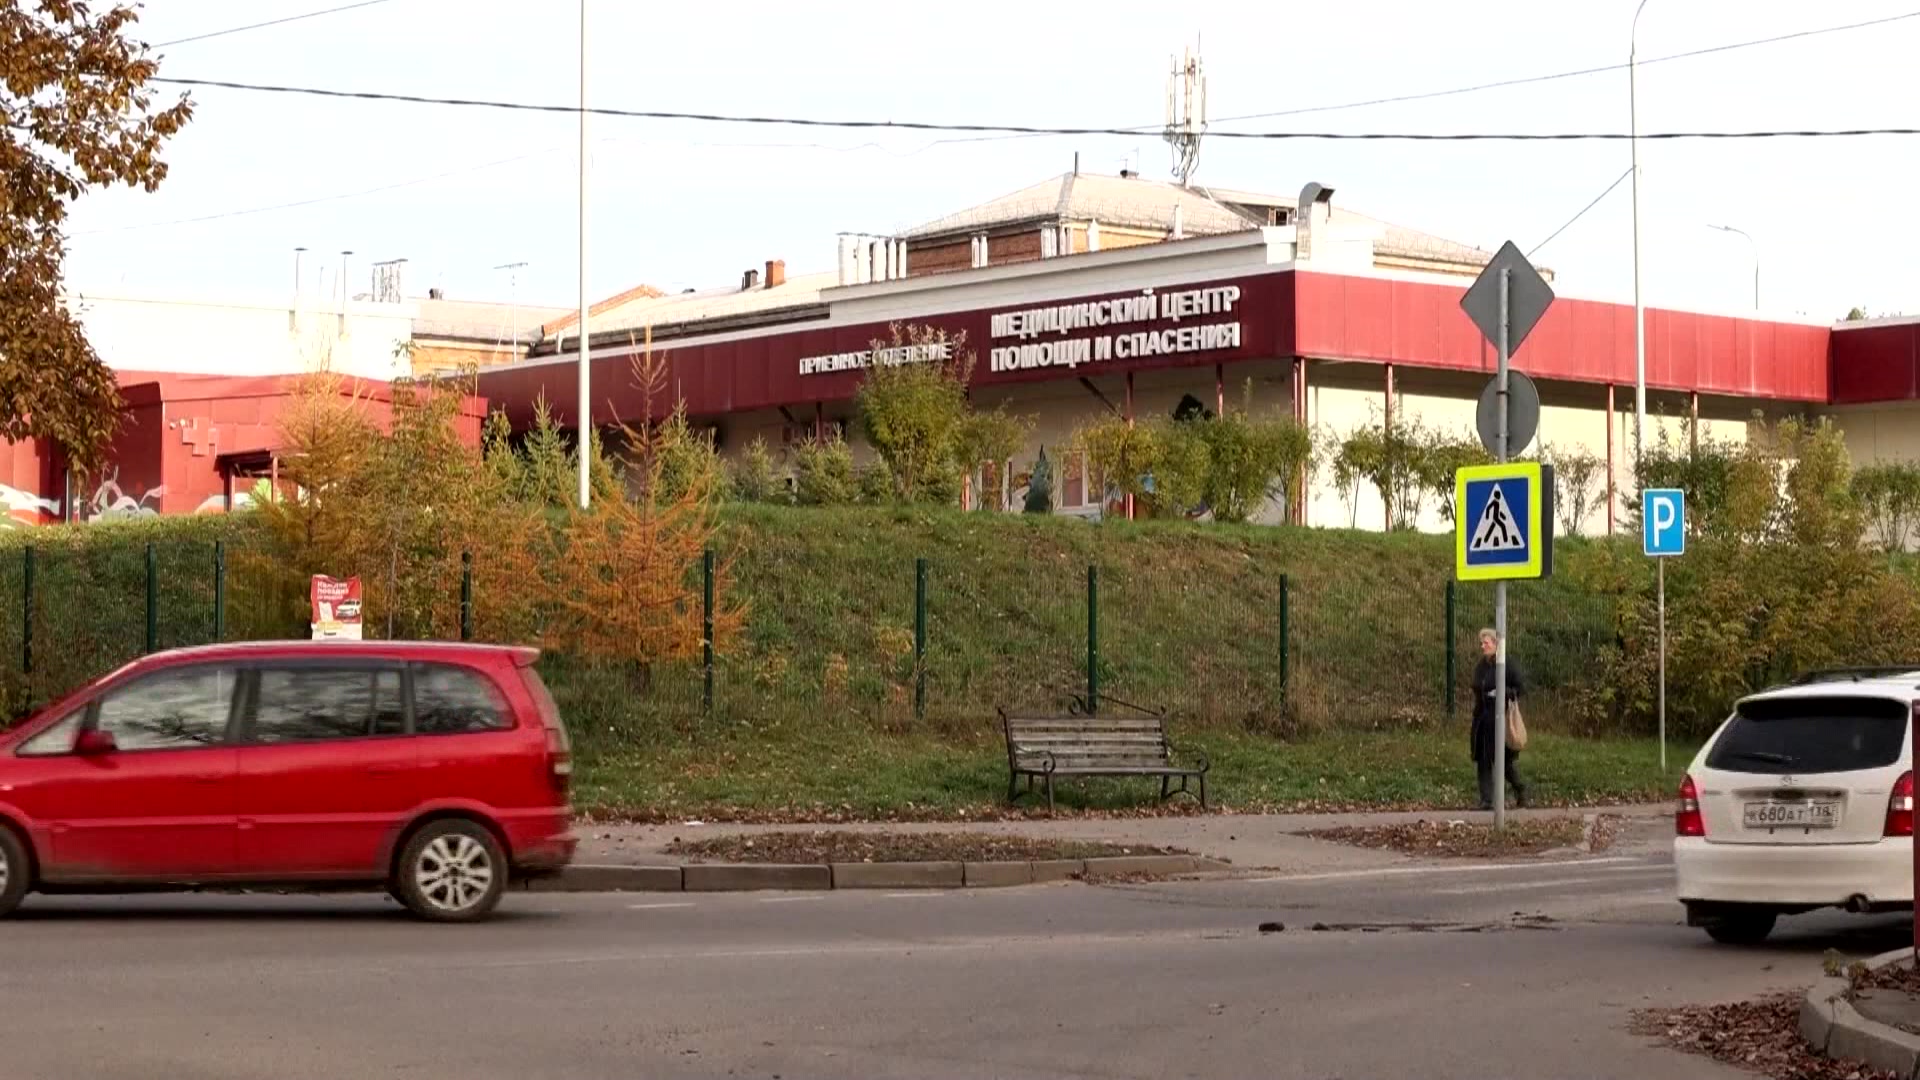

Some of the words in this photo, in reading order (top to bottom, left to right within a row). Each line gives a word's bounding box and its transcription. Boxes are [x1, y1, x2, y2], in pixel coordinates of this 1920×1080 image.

[990, 288, 1158, 339] МЕДИЦИНСКИЙ
[1160, 285, 1241, 322] ЦЕНТР
[799, 350, 871, 375] ПРИЕМНОЕ
[990, 337, 1091, 369] ПОМОЩИ
[1094, 335, 1112, 361] И
[1115, 322, 1241, 358] СПАСЕНИЯ
[1653, 496, 1675, 547] P
